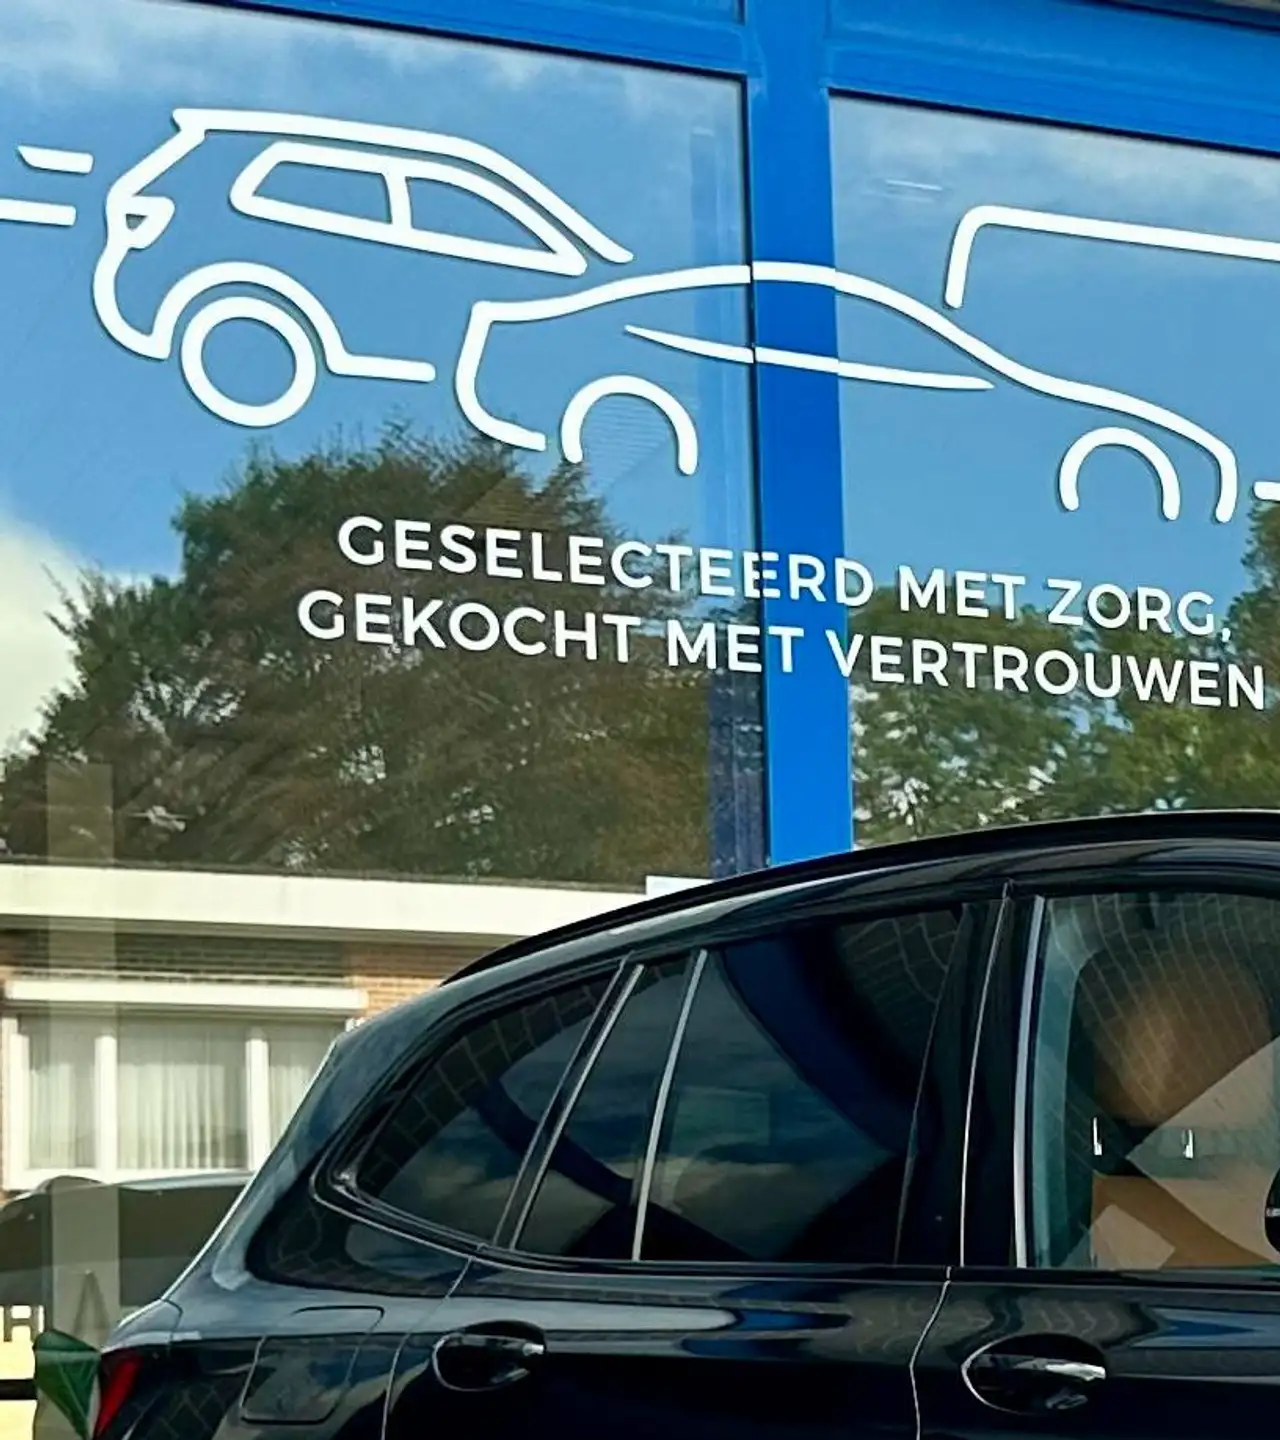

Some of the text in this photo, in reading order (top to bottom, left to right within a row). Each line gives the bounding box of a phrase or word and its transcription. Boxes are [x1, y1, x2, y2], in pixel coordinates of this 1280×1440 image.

[338, 516, 1232, 643] GESELECTEERD MET ZORG,
[298, 590, 1265, 710] GEKOCHT MET VERTROUWEN
